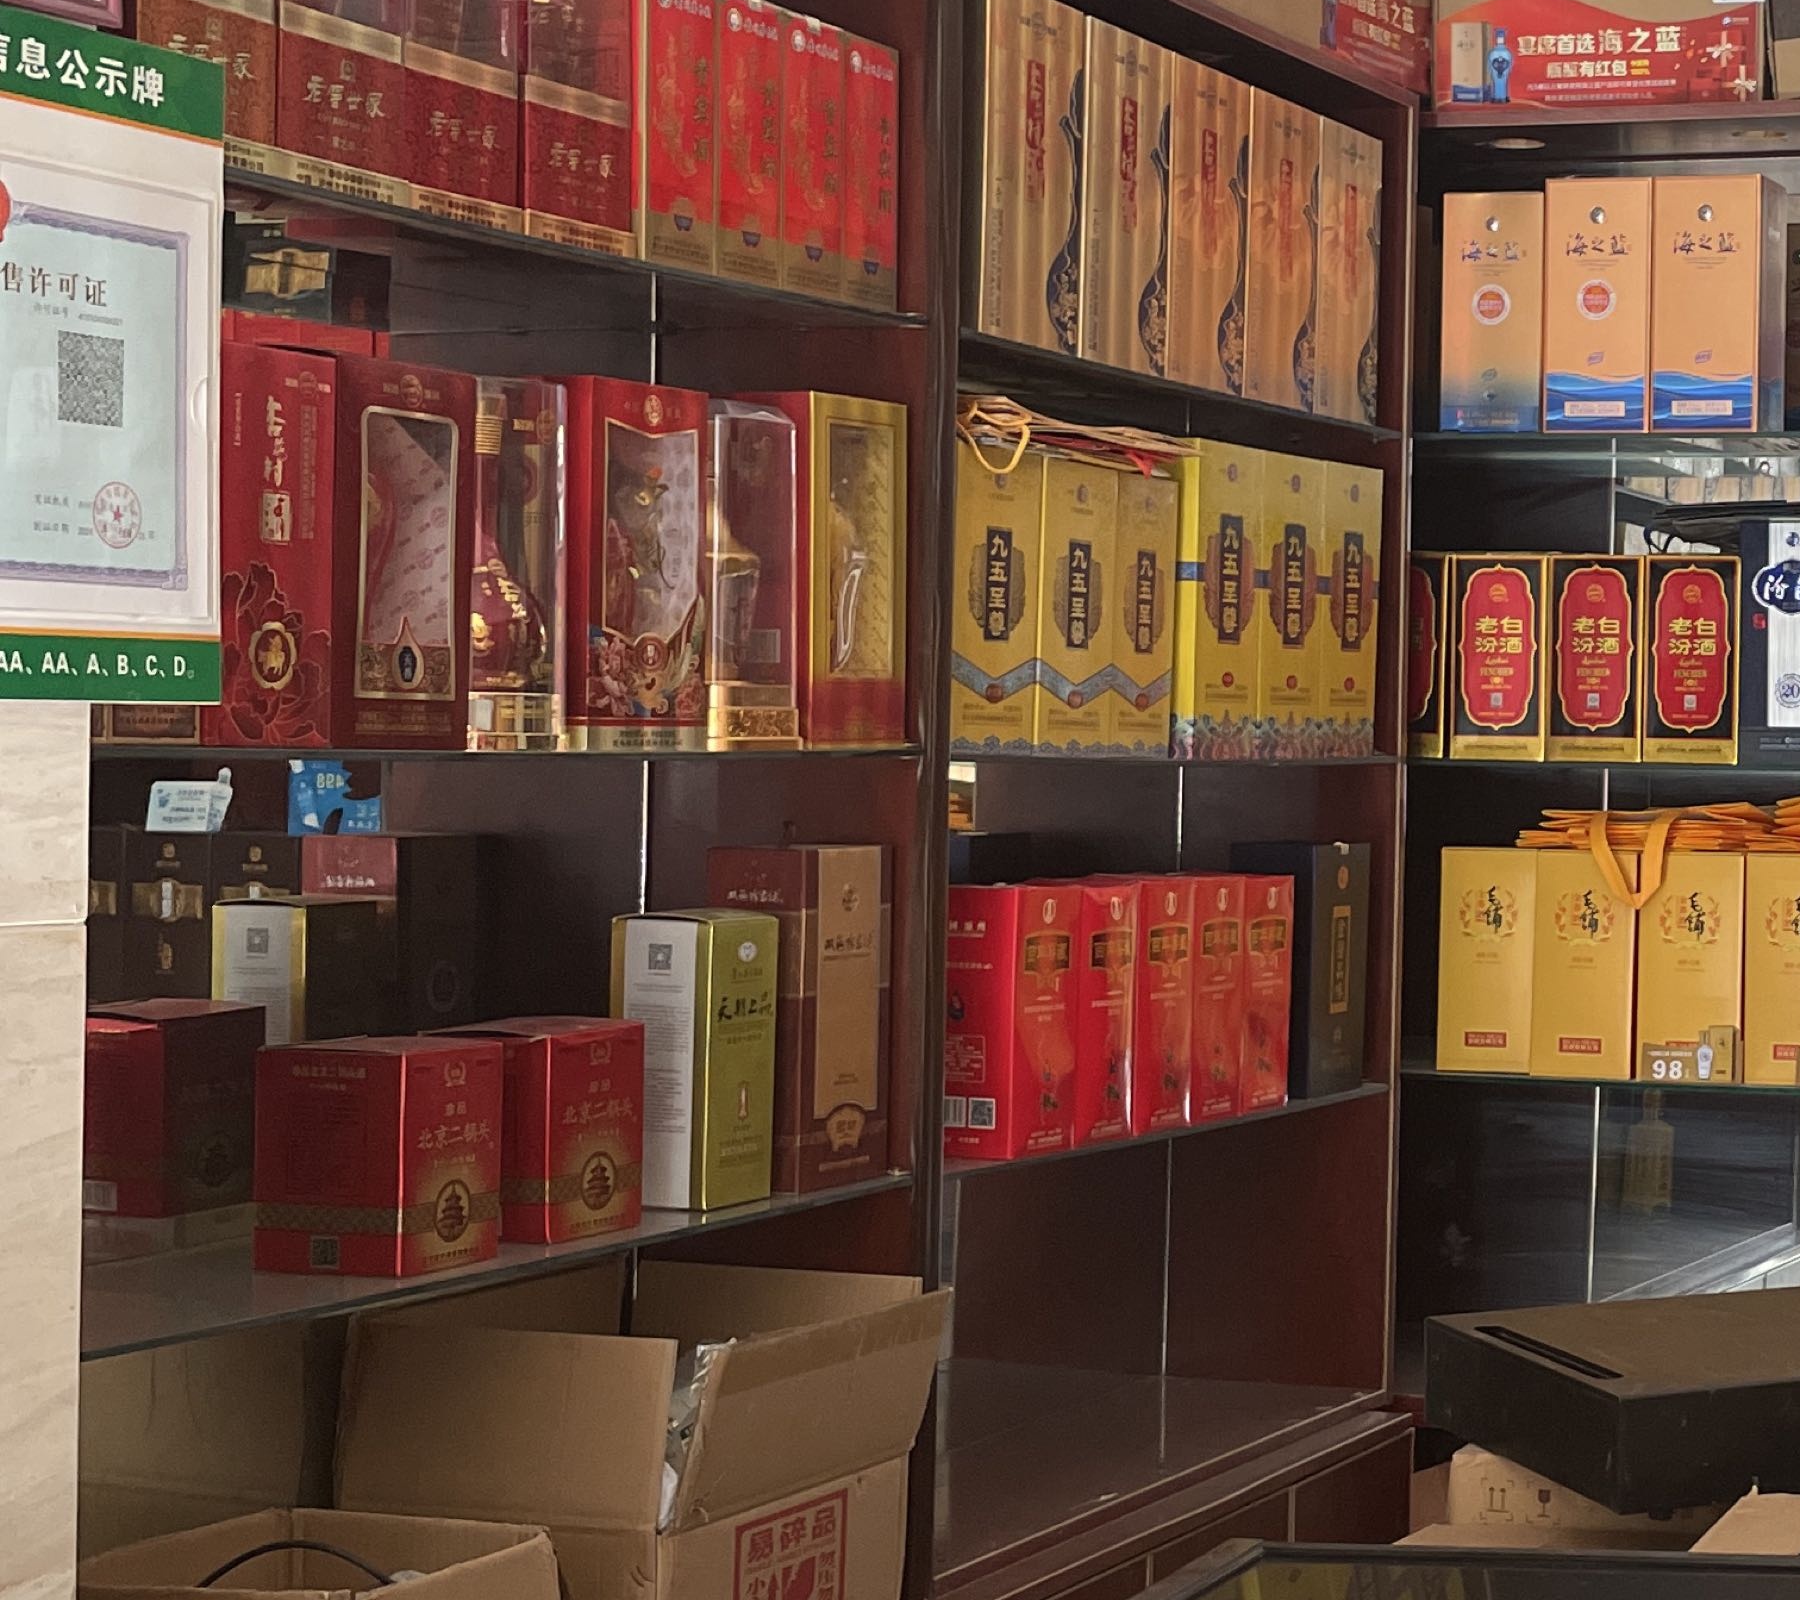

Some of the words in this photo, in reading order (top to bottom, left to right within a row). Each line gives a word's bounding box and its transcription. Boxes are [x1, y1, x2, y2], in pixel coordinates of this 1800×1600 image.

[1476, 637, 1524, 655] 汾酒
[1572, 637, 1620, 655] 汾酒
[1669, 637, 1717, 655] 汾酒
[1780, 683, 1800, 699] 20
[1652, 1059, 1683, 1080] 98
[748, 1505, 836, 1564] 易碎品
